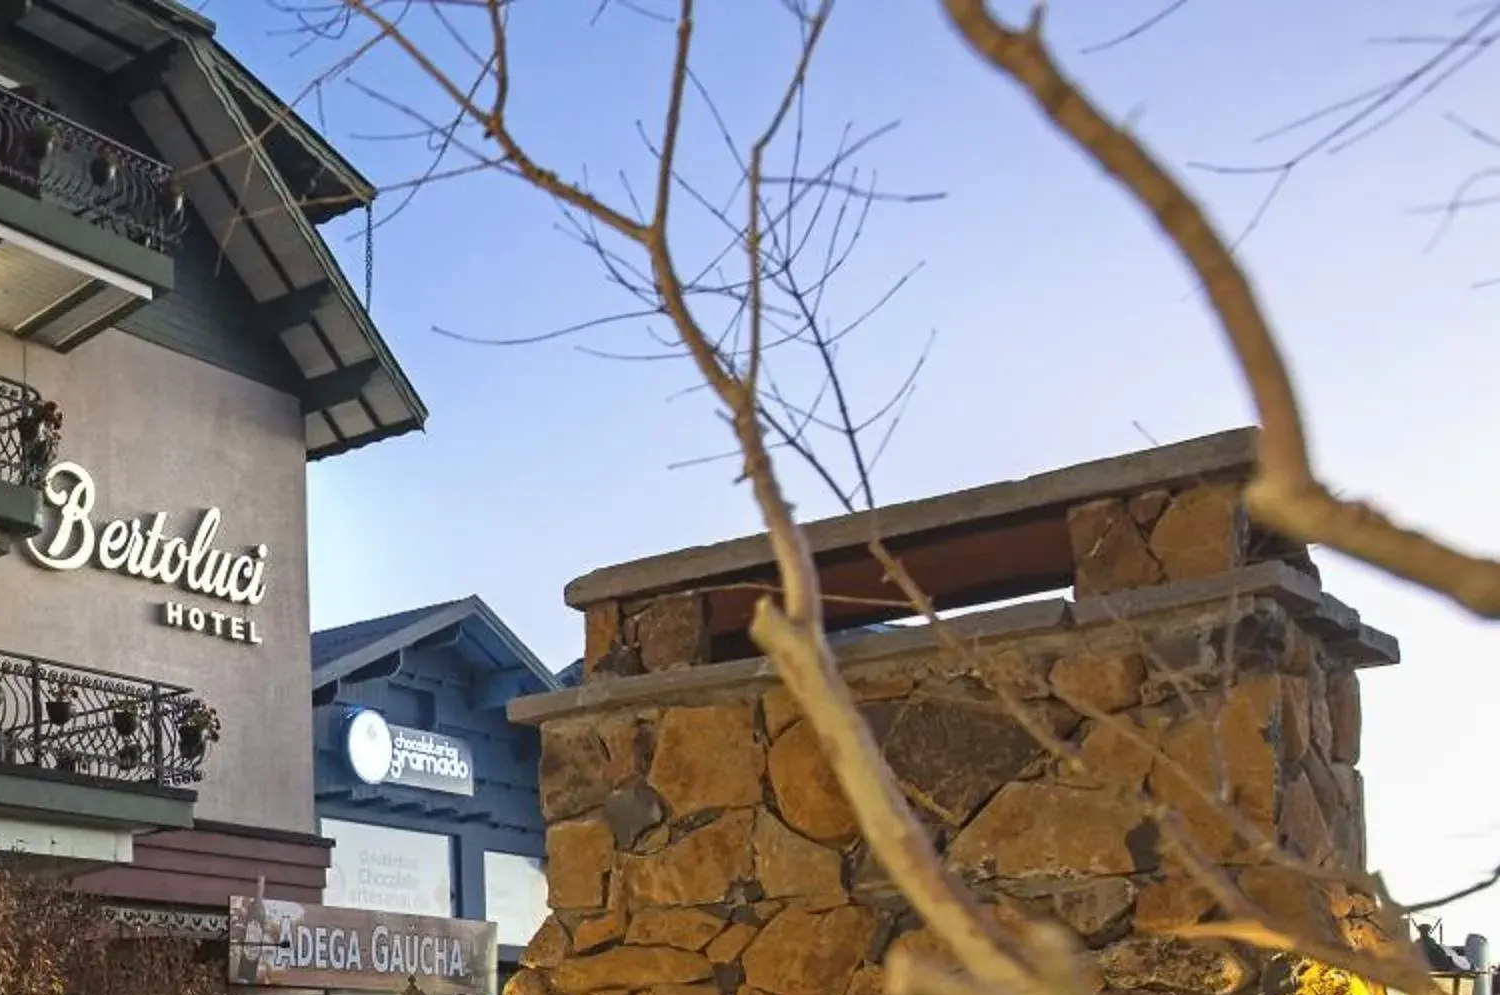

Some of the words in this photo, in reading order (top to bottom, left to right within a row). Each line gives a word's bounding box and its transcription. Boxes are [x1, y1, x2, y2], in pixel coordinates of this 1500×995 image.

[27, 461, 268, 605] Bertoluci
[165, 601, 263, 644] HOTEL
[390, 748, 469, 779] gramado
[276, 917, 363, 971] ADEGA
[371, 925, 465, 977] GAUCHA
